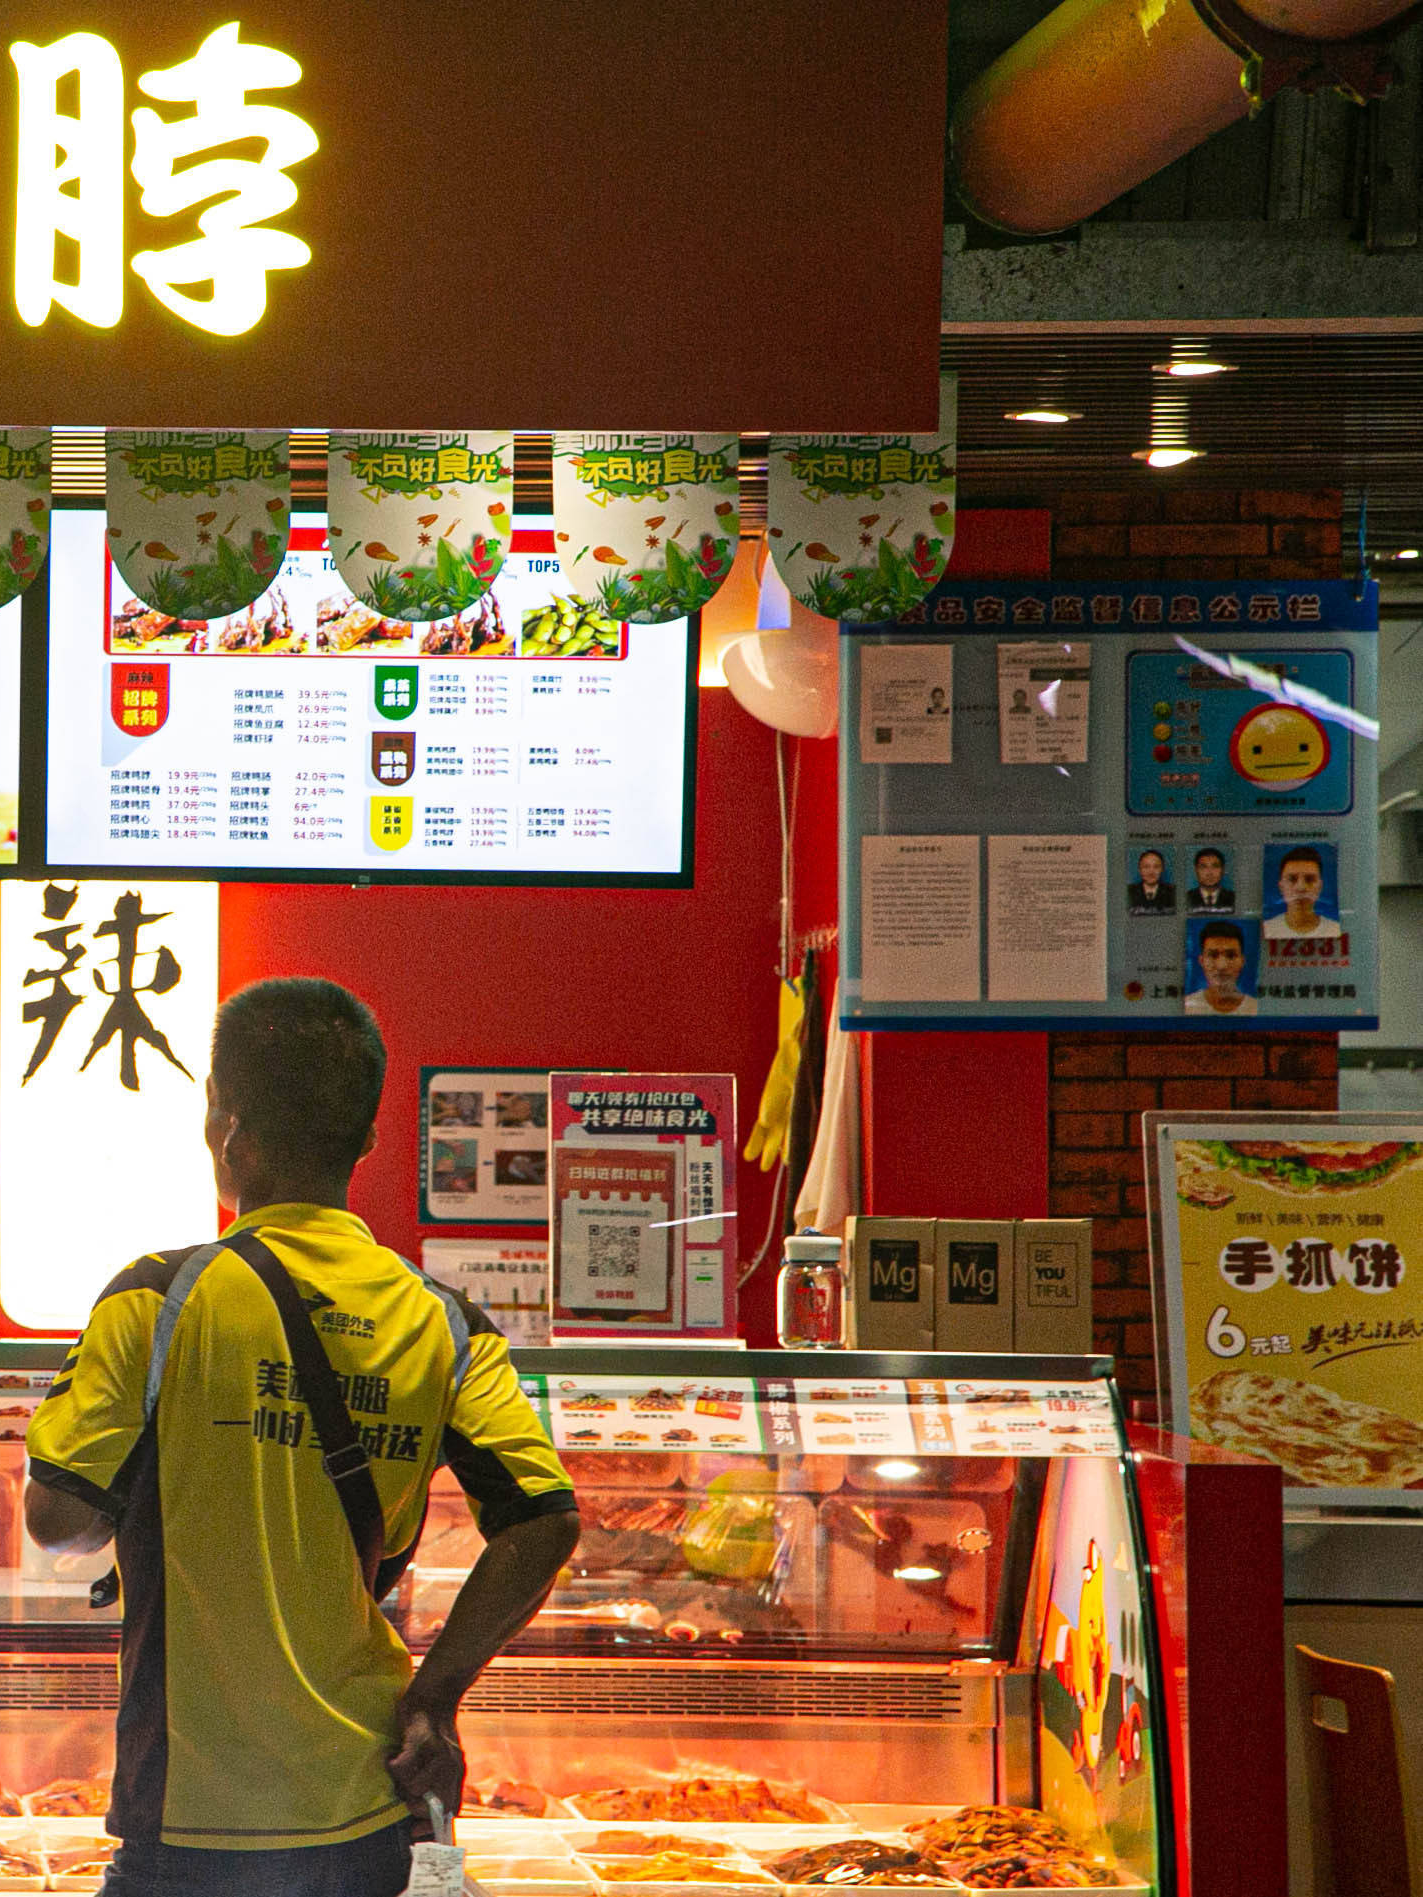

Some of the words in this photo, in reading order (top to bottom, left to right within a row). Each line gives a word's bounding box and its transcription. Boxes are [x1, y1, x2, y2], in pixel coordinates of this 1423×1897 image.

[137, 445, 276, 480] 不负好食光
[360, 447, 498, 483] 不负好食光
[584, 449, 725, 486] 不负好食光
[800, 449, 941, 484] 不负好食光
[123, 690, 158, 707] 招牌
[123, 709, 158, 726] 系列
[22, 881, 195, 1092] 辣
[580, 1108, 709, 1128] 共享绝味食光
[1035, 1250, 1053, 1264] BE
[1035, 1267, 1065, 1280] YOU
[1225, 1241, 1400, 1288] 手抓饼
[873, 1259, 918, 1293] Mg
[952, 1261, 996, 1295] Mg
[320, 1311, 376, 1332] 美团外卖
[1301, 1318, 1423, 1354] 美味无法抵
[213, 1406, 423, 1461] 一小时城送
